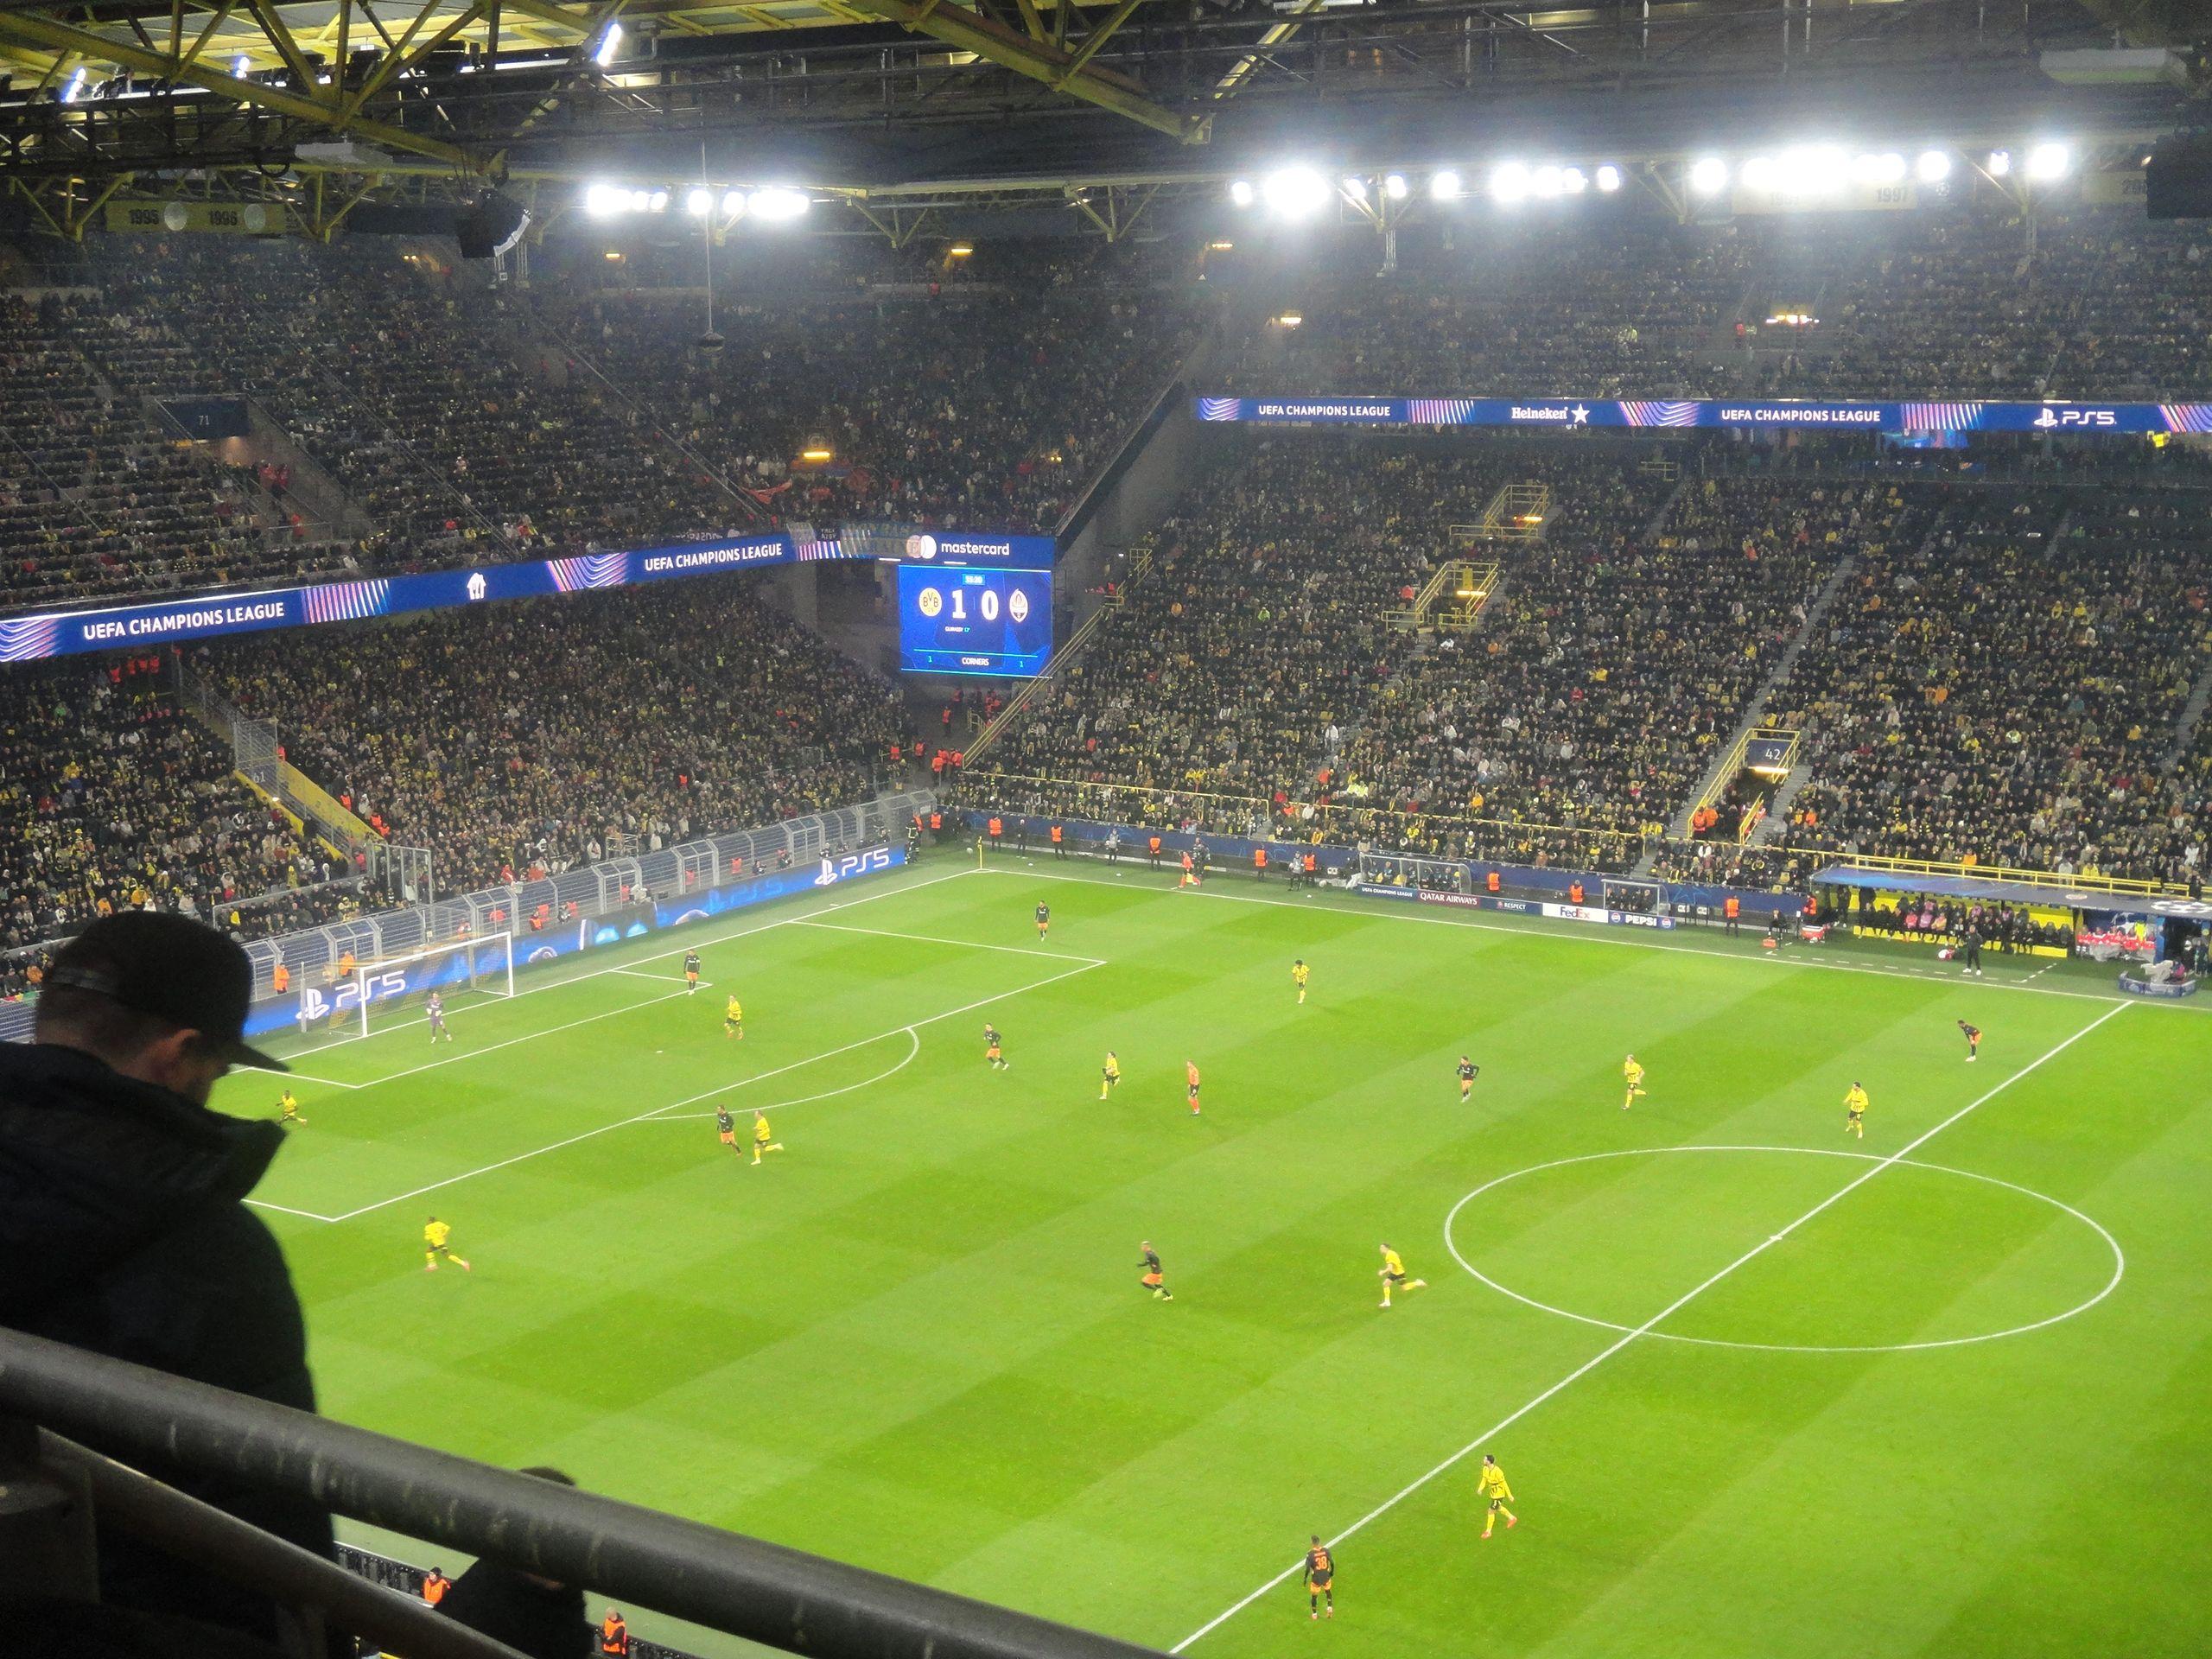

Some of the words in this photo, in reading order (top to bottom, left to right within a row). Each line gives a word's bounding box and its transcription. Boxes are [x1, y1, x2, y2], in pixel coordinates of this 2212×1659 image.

[1259, 405, 1285, 416] UEFA
[1287, 405, 1348, 416] CHAMPIONS
[1350, 406, 1391, 416] LEAGUE
[1511, 407, 1567, 420] Heineken
[1721, 410, 1752, 421] UEFA
[1755, 410, 1829, 422] CHAMPIONS
[1832, 410, 1881, 422] LEAGUE
[199, 415, 210, 426] 71
[2063, 411, 2115, 425] PS5
[941, 542, 1010, 556] mastercard
[645, 556, 674, 571] UEFA
[677, 548, 741, 568] CHAMPIONS
[742, 543, 782, 560] LEAGUE
[923, 592, 939, 607] BVB
[951, 589, 966, 619] 1
[981, 590, 999, 620] 0
[84, 622, 126, 640] UEFA
[130, 610, 224, 635] CHAMPIONS
[226, 602, 285, 623] LEAGUE
[962, 657, 989, 666] CORNERS
[1765, 748, 1781, 760] 42
[841, 848, 889, 877] PS5
[1420, 892, 1446, 902] QATAR
[1446, 894, 1478, 906] AIRWAYS
[1560, 906, 1591, 919] FedEx
[1625, 914, 1657, 926] PEPSI
[335, 969, 406, 1007] PS5
[1315, 1556, 1328, 1570] 38
